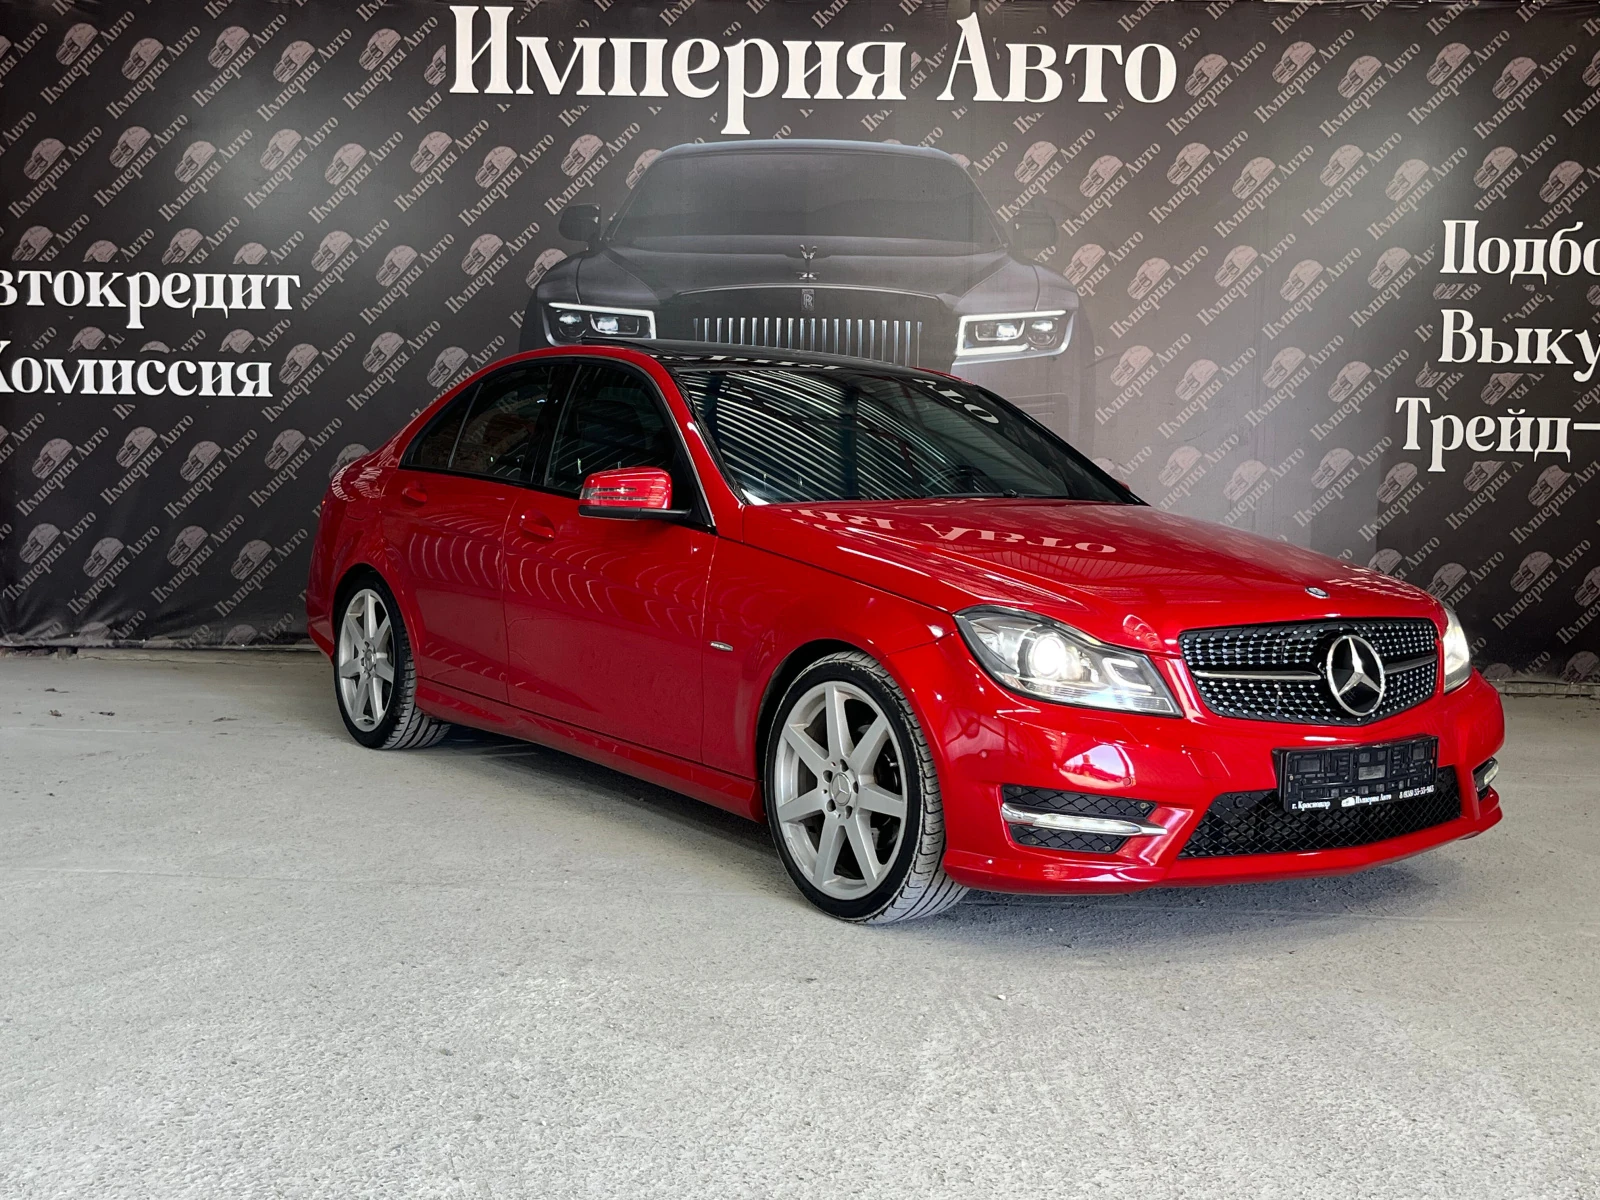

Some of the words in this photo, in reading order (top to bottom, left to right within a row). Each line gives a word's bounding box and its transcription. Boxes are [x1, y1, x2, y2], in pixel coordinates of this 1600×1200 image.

[14, 23, 48, 57] Авто
[41, 43, 103, 104] Империя
[101, 11, 134, 46] Авто
[106, 58, 170, 119] Империя
[166, 26, 201, 60] Авто
[192, 46, 255, 107] Империя
[253, 14, 286, 49] Авто
[257, 61, 321, 122] Империя
[318, 29, 352, 63] Авто
[343, 48, 406, 109] Империя
[404, 16, 437, 51] Авто
[449, 5, 906, 135] Империя
[936, 12, 1177, 103] Авто
[1254, 62, 1321, 123] Империя
[1319, 29, 1354, 64] Авто
[1407, 63, 1476, 125] Империя
[1474, 30, 1510, 65] Авто
[3, 111, 36, 146] Авто
[1167, 74, 1233, 136] Империя
[1231, 42, 1266, 76] Авто
[1319, 76, 1387, 138] Империя
[1385, 44, 1420, 78] Авто
[1473, 77, 1542, 139] Империя
[1540, 45, 1576, 79] Авто
[8, 158, 72, 219] Империя
[68, 127, 102, 160] Авто
[94, 146, 157, 206] Империя
[154, 114, 187, 149] Авто
[158, 161, 222, 222] Империя
[219, 129, 253, 163] Авто
[244, 148, 307, 209] Империя
[305, 117, 338, 151] Авто
[308, 163, 372, 224] Империя
[369, 132, 404, 165] Авто
[394, 151, 457, 211] Империя
[455, 120, 488, 154] Авто
[459, 166, 523, 227] Империя
[520, 135, 554, 168] Авто
[544, 154, 608, 215] Империя
[606, 122, 639, 157] Авто
[918, 127, 944, 147] вто
[971, 141, 1008, 176] Авто
[997, 161, 1063, 222] Империя
[1060, 129, 1095, 163] Авто
[1148, 163, 1215, 224] Империя
[1213, 131, 1249, 165] Авто
[1301, 165, 1369, 226] Империя
[1367, 132, 1402, 167] Авто
[1474, 166, 1523, 211] перия
[1521, 134, 1556, 169] Авто
[56, 214, 90, 248] Авто
[205, 216, 240, 250] Авто
[1062, 175, 1128, 237] Империя
[1126, 144, 1161, 177] Авто
[1214, 177, 1281, 239] Империя
[1279, 145, 1314, 179] Авто
[1367, 179, 1434, 241] Империя
[1432, 148, 1468, 181] Авто
[120, 228, 155, 262] Авто
[270, 230, 305, 265] Авто
[356, 219, 389, 253] Авто
[359, 265, 423, 325] Империя
[420, 234, 455, 267] Авто
[445, 253, 508, 313] Империя
[506, 222, 539, 256] Авто
[1077, 263, 1110, 297] ерия
[1108, 232, 1144, 265] Авто
[1197, 265, 1263, 325] Империя
[1261, 234, 1296, 267] Авто
[257, 319, 292, 351] Авто
[1110, 277, 1176, 339] Империя
[1174, 246, 1209, 280] Авто
[1262, 279, 1329, 340] Империя
[1327, 248, 1362, 282] Авто
[1350, 267, 1416, 327] Империя
[32, 327, 57, 351] вто
[181, 329, 206, 352] вто
[262, 363, 325, 423] Империя
[322, 332, 356, 365] Авто
[347, 351, 409, 410] Империя
[407, 321, 440, 354] Авто
[471, 336, 505, 369] Авто
[1156, 334, 1191, 367] Авто
[1245, 367, 1311, 426] Империя
[1308, 336, 1344, 369] Авто
[12, 413, 44, 446] Авто
[1158, 379, 1224, 439] Империя
[1222, 348, 1257, 381] Авто
[1310, 381, 1376, 441] Империя
[1374, 350, 1409, 383] Авто
[17, 458, 79, 517] Империя
[76, 427, 109, 460] Авто
[100, 446, 163, 504] Империя
[160, 415, 193, 449] Авто
[165, 460, 227, 519] Империя
[224, 430, 258, 462] Авто
[248, 449, 311, 507] Империя
[308, 418, 342, 450] Авто
[1118, 446, 1153, 480] Авто
[1160, 467, 1207, 511] перия
[1204, 435, 1239, 467] Авто
[1270, 449, 1305, 482] Авто
[1293, 468, 1360, 527] Империя
[1357, 437, 1392, 470] Авто
[1444, 471, 1512, 529] Империя
[4, 542, 66, 600] Империя
[63, 512, 96, 545] Авто
[1359, 482, 1425, 542] Империя
[1405, 537, 1440, 571] Авто
[1509, 485, 1576, 544] Империя
[67, 556, 130, 615] Империя
[127, 526, 160, 559] Авто
[151, 545, 213, 603] Империя
[211, 514, 244, 548] Авто
[215, 559, 277, 618] Империя
[275, 529, 308, 561] Авто
[1469, 552, 1504, 585] Авто
[1492, 571, 1558, 630] Империя
[1556, 540, 1591, 573] Авто
